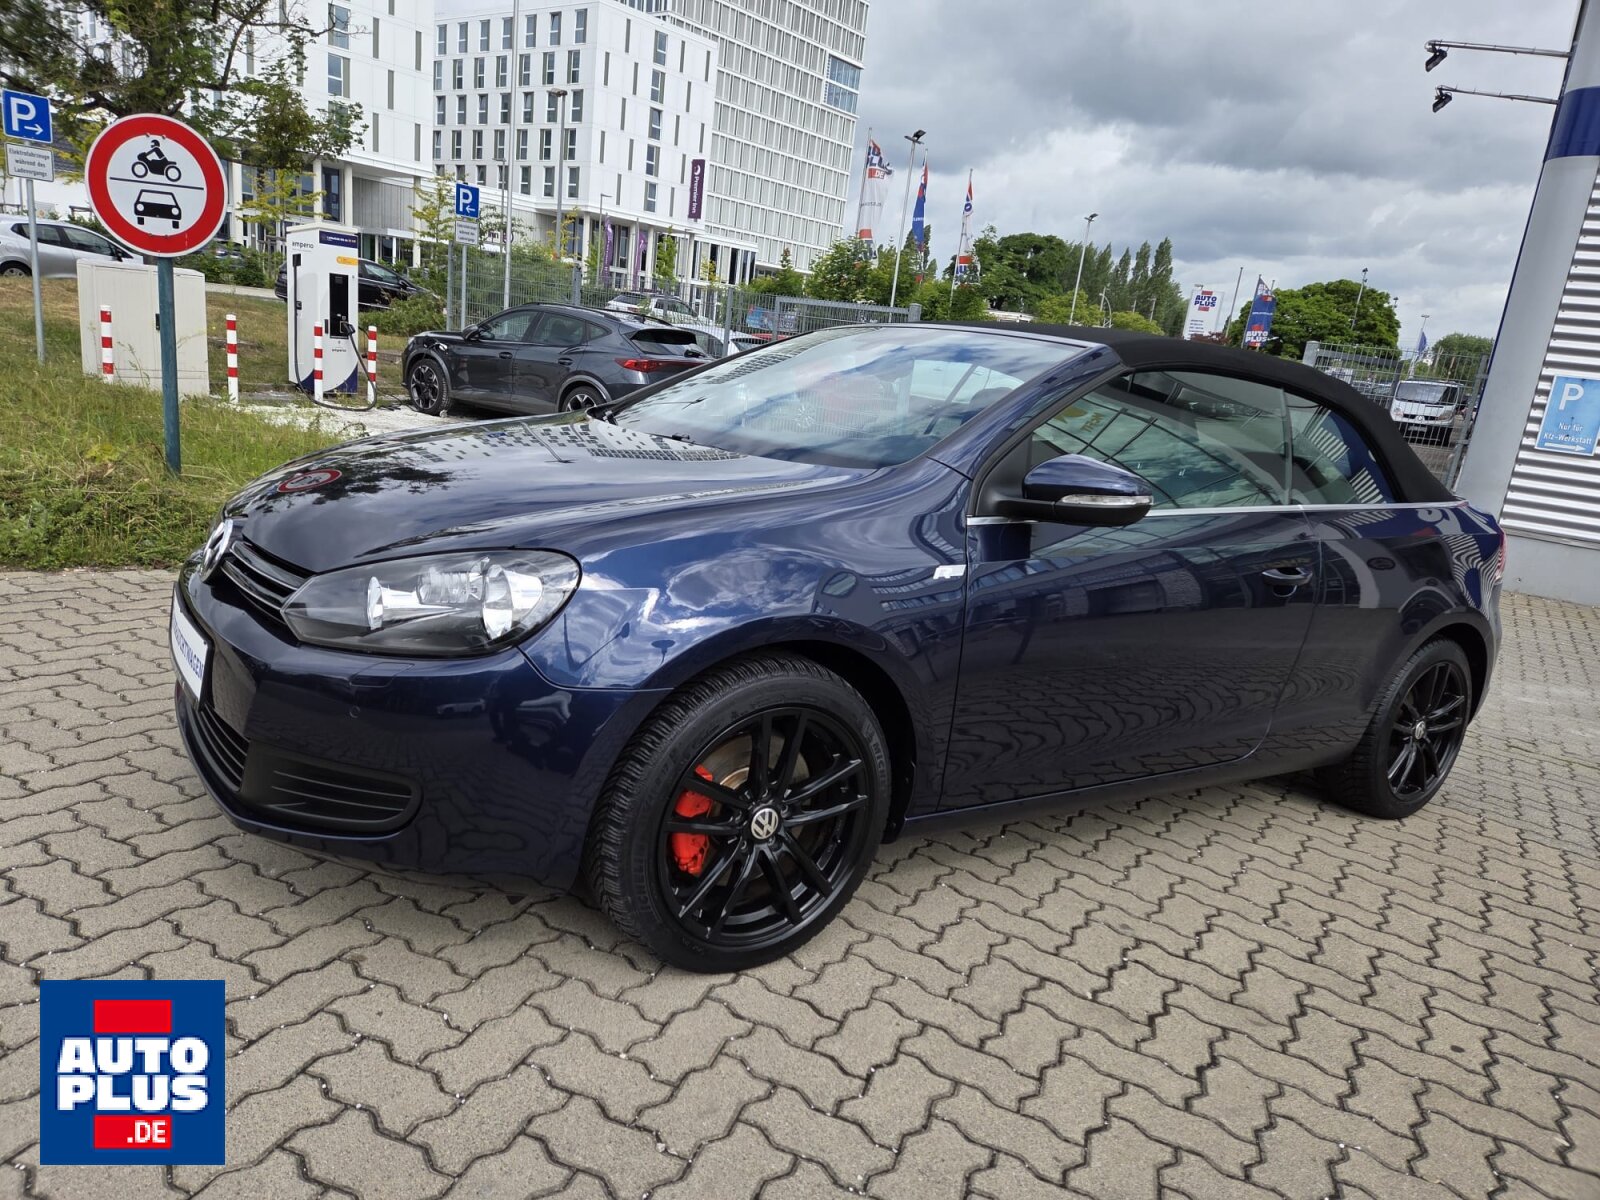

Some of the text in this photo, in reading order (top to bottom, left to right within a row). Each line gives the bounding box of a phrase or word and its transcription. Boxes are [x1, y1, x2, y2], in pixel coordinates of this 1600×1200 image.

[10, 97, 36, 131] P
[459, 188, 473, 212] P
[692, 176, 700, 203] Premier
[1558, 383, 1585, 411] P
[1543, 432, 1592, 445] Kfz-Werkstatt
[1558, 422, 1584, 433] Nur für
